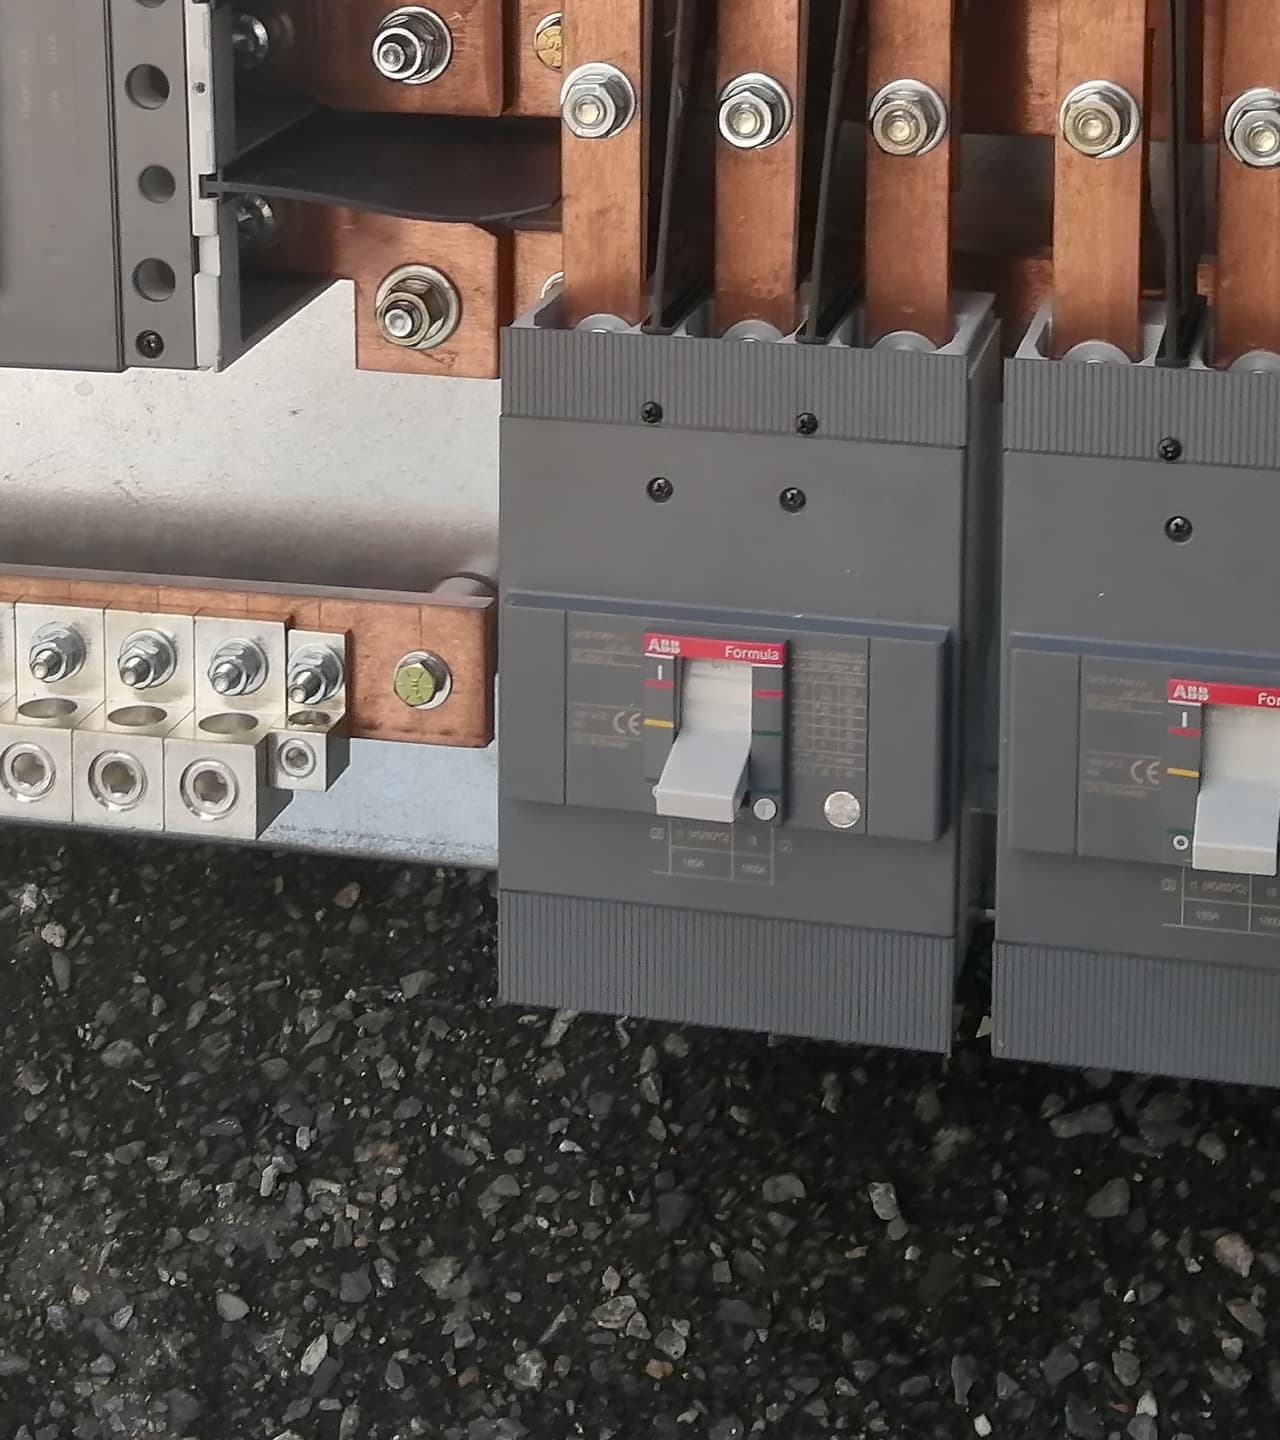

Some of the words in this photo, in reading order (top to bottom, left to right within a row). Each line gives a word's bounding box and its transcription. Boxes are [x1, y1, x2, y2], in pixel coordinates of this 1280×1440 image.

[648, 638, 681, 654] ABB
[725, 646, 780, 661] Formula
[1173, 684, 1210, 702] ABB
